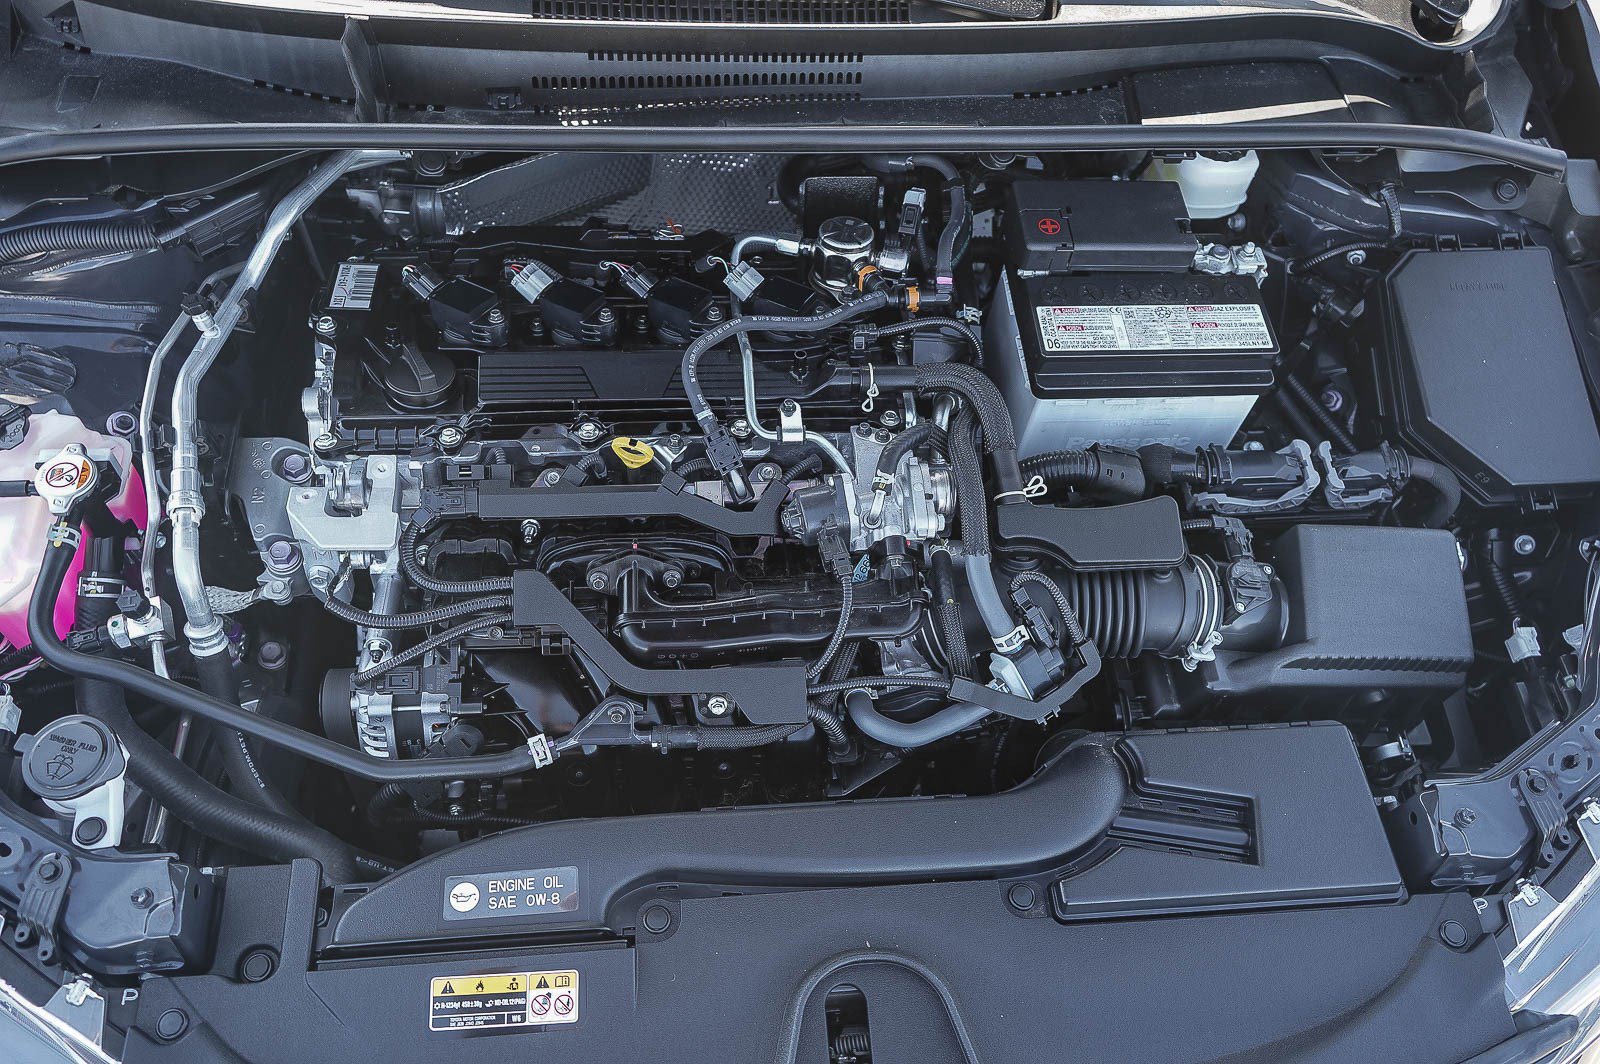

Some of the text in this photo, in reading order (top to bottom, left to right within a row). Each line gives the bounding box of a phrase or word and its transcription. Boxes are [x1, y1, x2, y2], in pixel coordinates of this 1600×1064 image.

[488, 876, 563, 893] ENGINE OIL
[488, 895, 517, 909] SAE
[1472, 897, 1489, 915] P
[121, 988, 139, 1006] P
